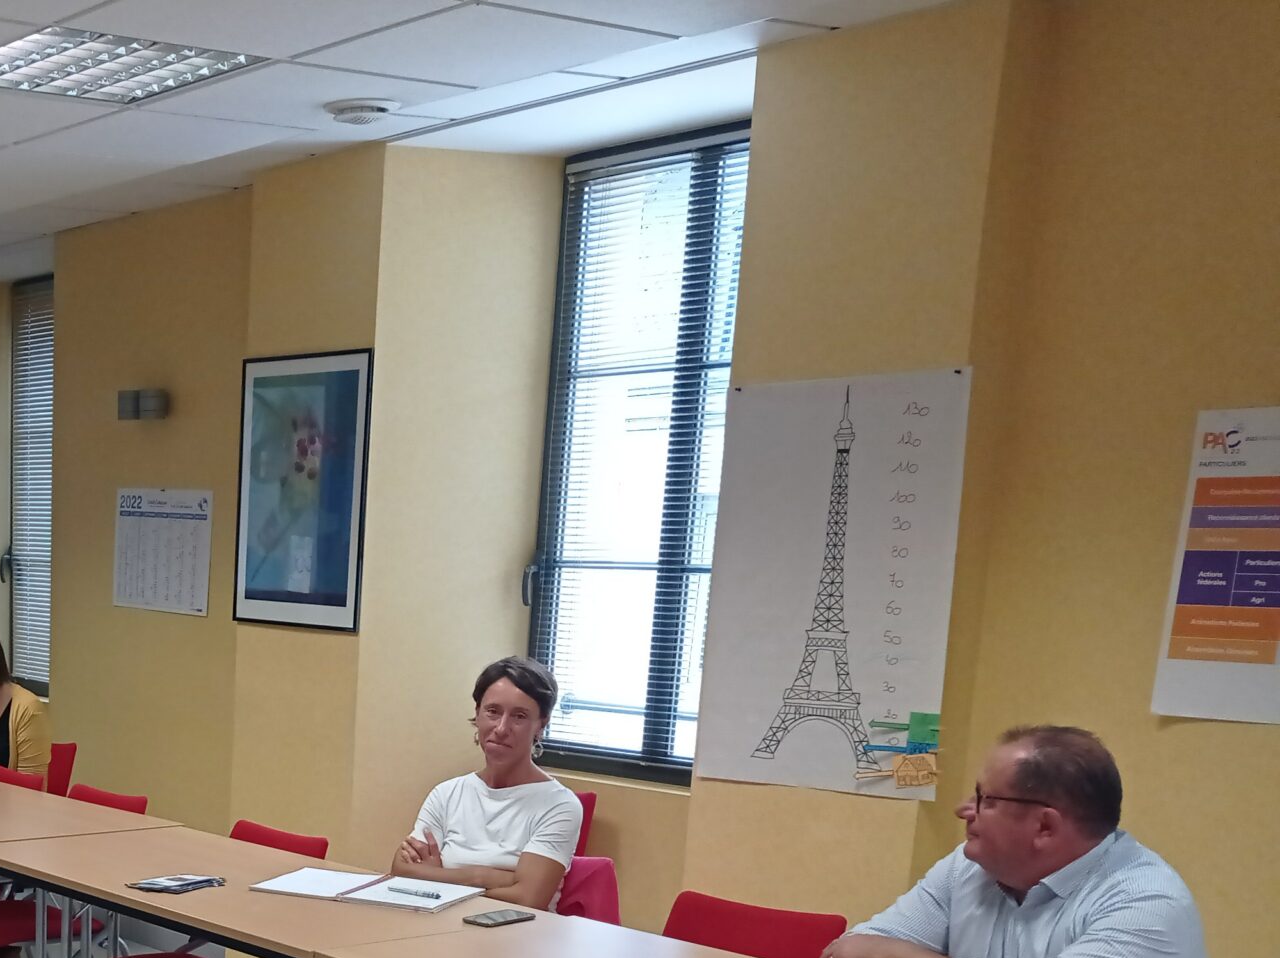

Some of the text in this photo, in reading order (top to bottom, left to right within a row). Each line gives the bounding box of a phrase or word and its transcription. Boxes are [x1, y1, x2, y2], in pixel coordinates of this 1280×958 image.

[902, 401, 929, 416] 130
[897, 431, 922, 447] 120
[120, 495, 143, 509] 2022
[889, 490, 917, 503] 100
[892, 516, 911, 531] 90
[891, 545, 909, 558] 80
[889, 572, 904, 589] 70
[885, 600, 902, 616] 60
[883, 629, 902, 645] 50
[883, 681, 896, 693] 30
